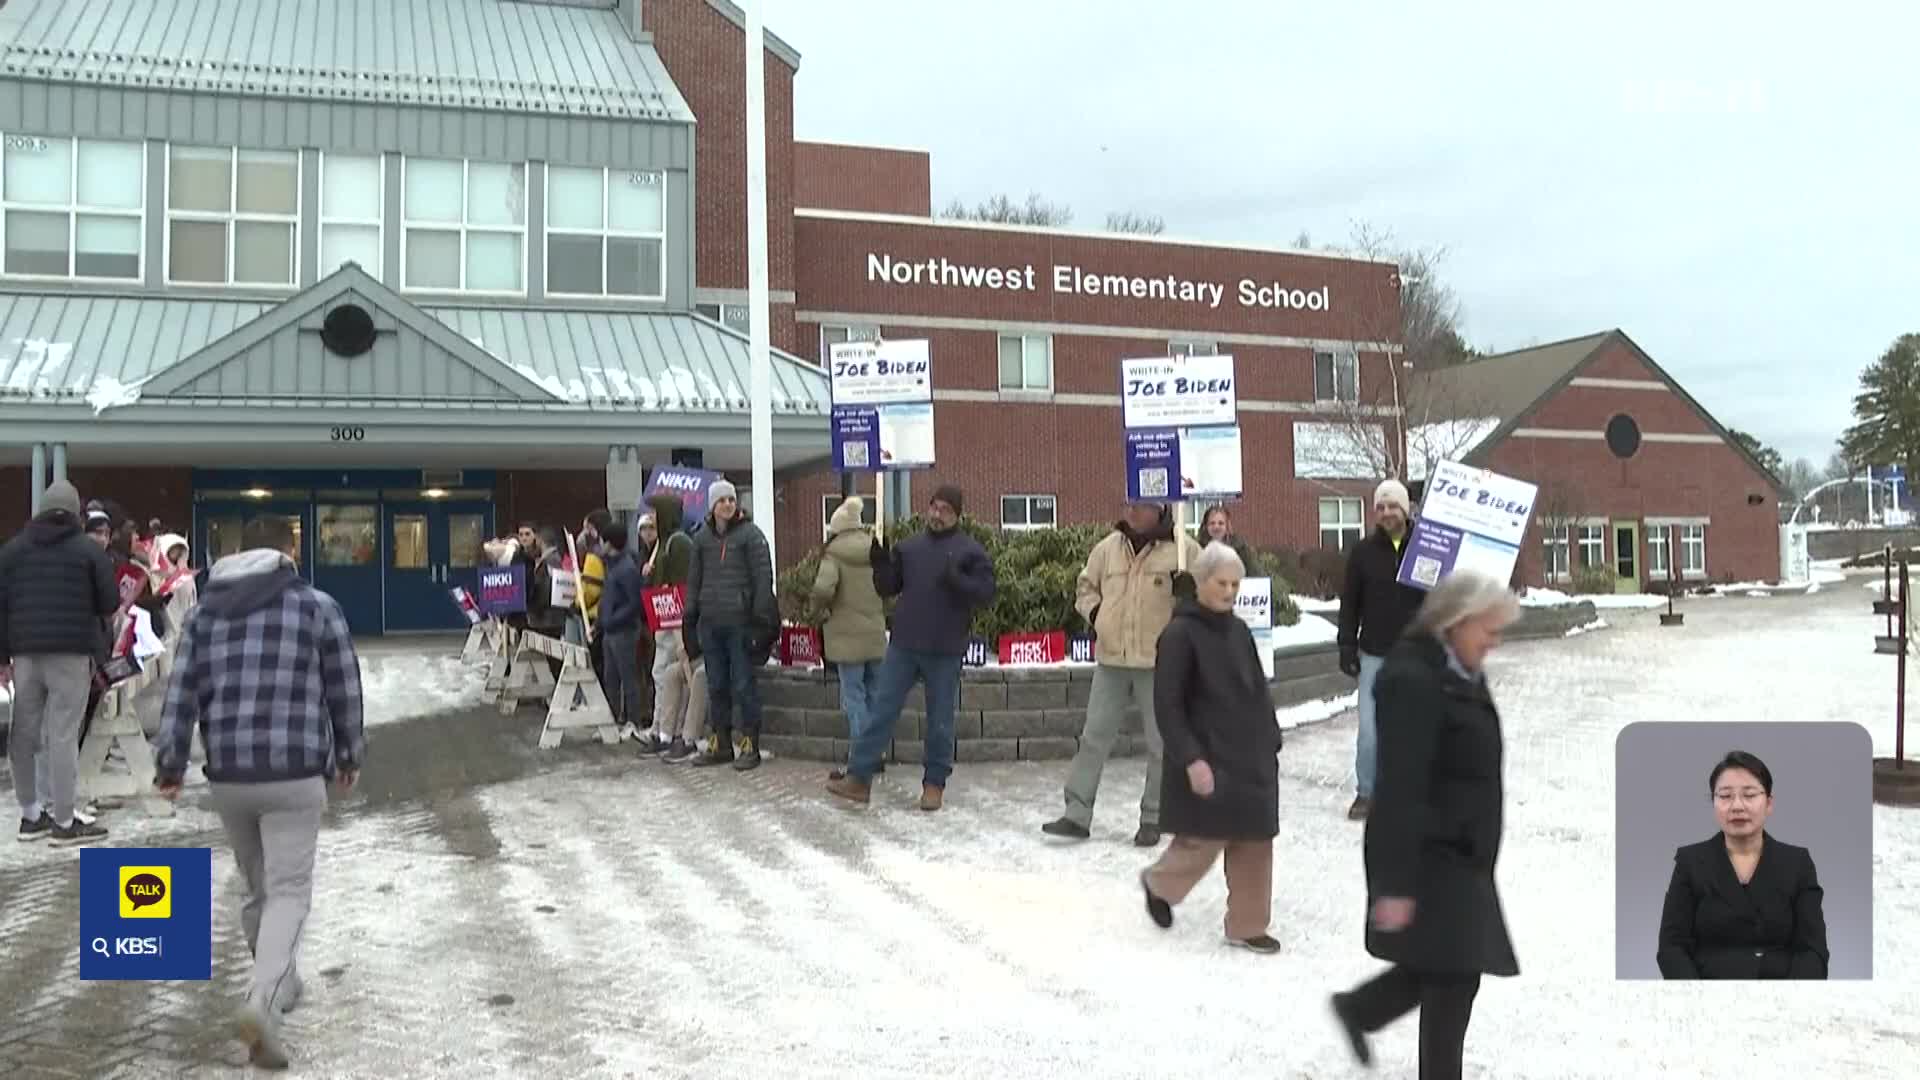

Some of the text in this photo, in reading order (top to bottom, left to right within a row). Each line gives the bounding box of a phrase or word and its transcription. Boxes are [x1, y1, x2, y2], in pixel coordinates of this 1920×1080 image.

[867, 253, 1329, 310] Northwest Elementary School
[834, 359, 927, 377] JOE BIDEN
[1127, 377, 1231, 396] JOE BIDEN
[331, 428, 365, 441] 300
[656, 472, 702, 491] NIKKI
[1433, 478, 1470, 501] JOE
[1476, 490, 1528, 516] BIDEN
[483, 572, 512, 587] NIKKI
[1234, 595, 1268, 607] IDEN
[1011, 641, 1041, 652] PICK
[1072, 640, 1091, 660] NH
